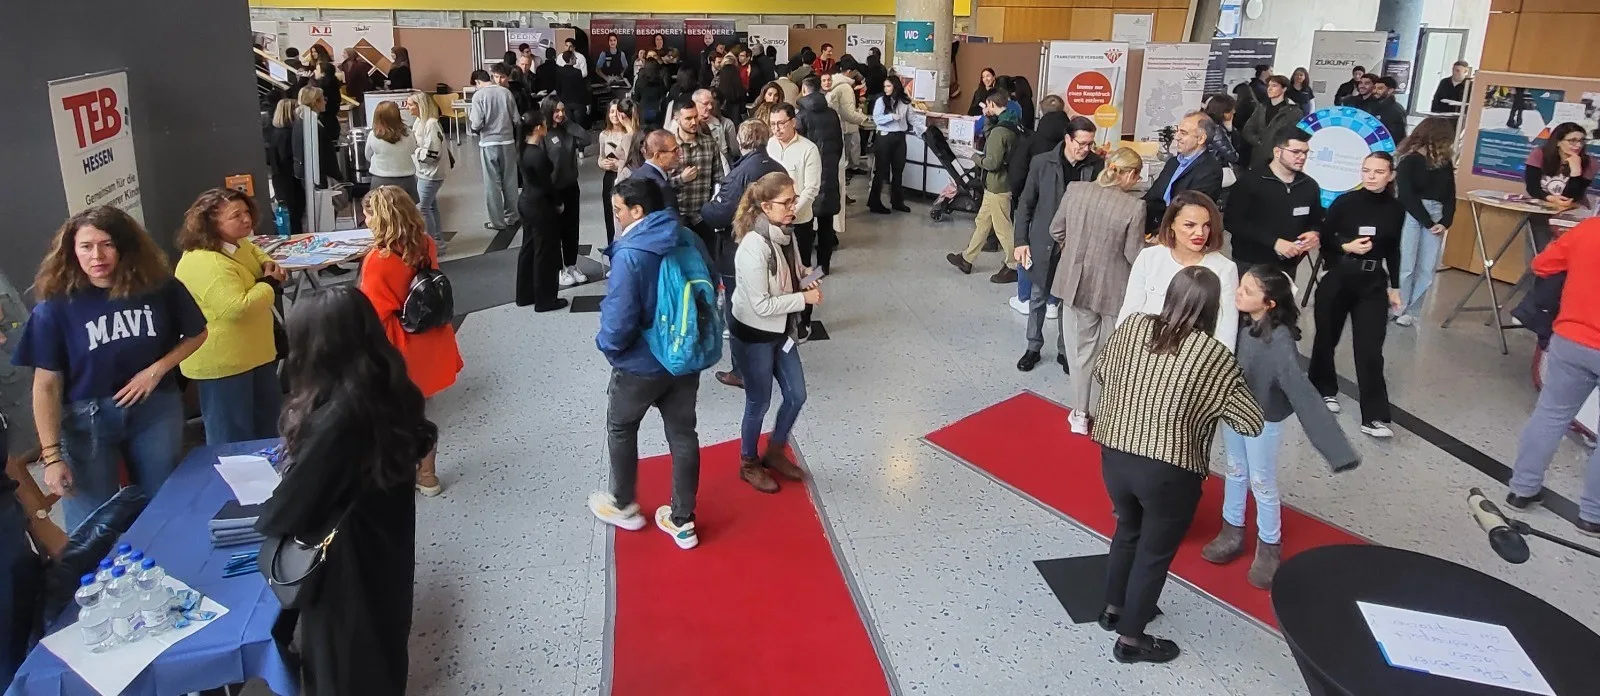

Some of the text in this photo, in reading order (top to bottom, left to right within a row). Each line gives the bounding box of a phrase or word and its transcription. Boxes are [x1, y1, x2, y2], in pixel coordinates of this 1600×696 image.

[636, 28, 683, 36] BESONDERE?
[687, 28, 735, 36] BESONDERE?
[904, 30, 919, 40] WC
[62, 87, 122, 149] TEB
[82, 147, 114, 175] HESSEN
[85, 183, 116, 206] Gemeinsam
[116, 177, 125, 188] für
[127, 173, 136, 184] die
